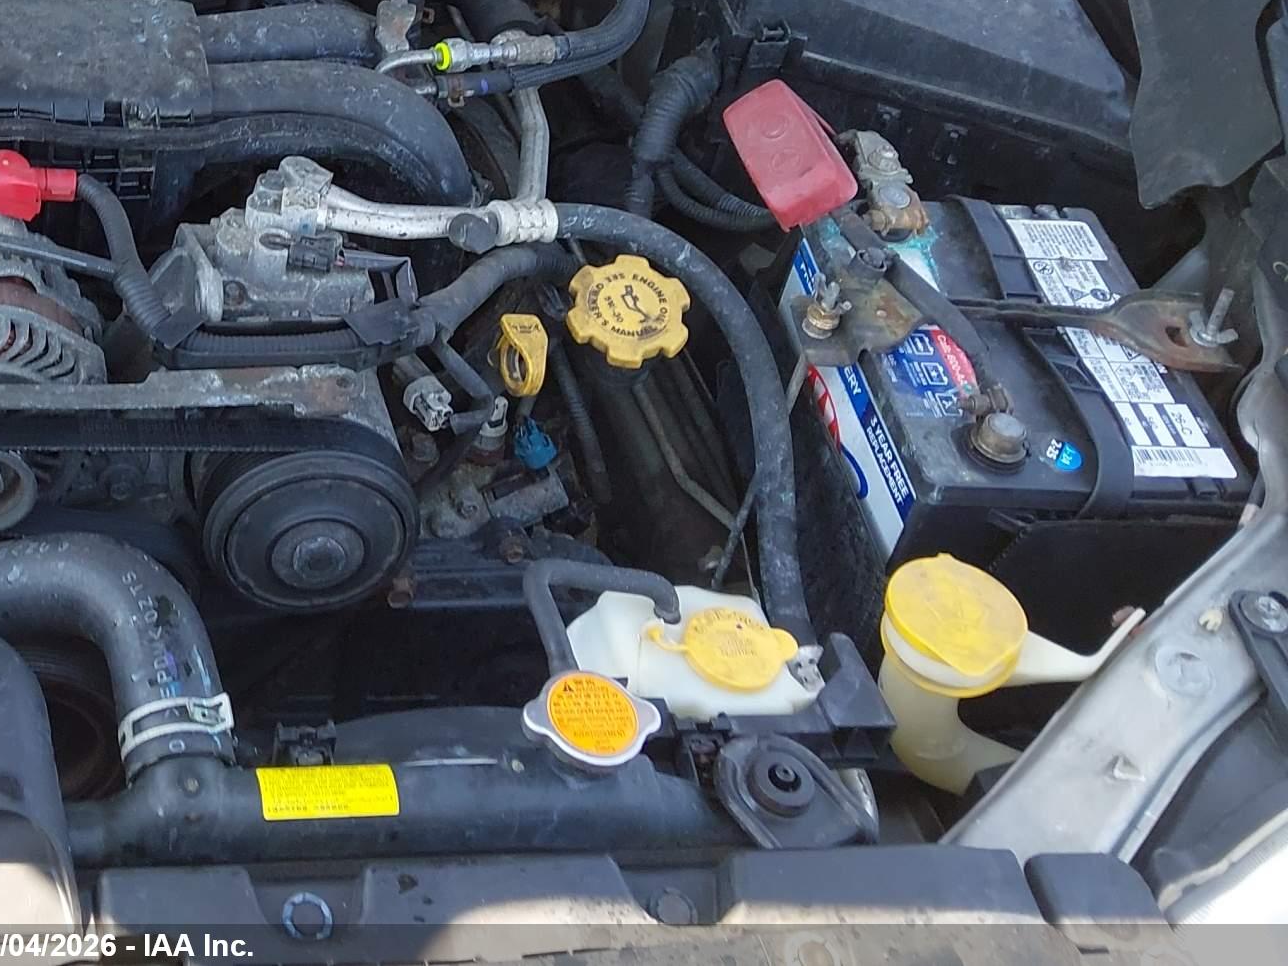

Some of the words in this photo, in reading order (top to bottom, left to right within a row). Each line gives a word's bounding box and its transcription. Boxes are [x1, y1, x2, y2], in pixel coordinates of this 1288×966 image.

[632, 273, 667, 304] ENGINE
[866, 425, 904, 505] REPLACEMENT
[870, 415, 878, 428] 3
[875, 424, 893, 462] YEAR
[890, 460, 910, 499] FREE
